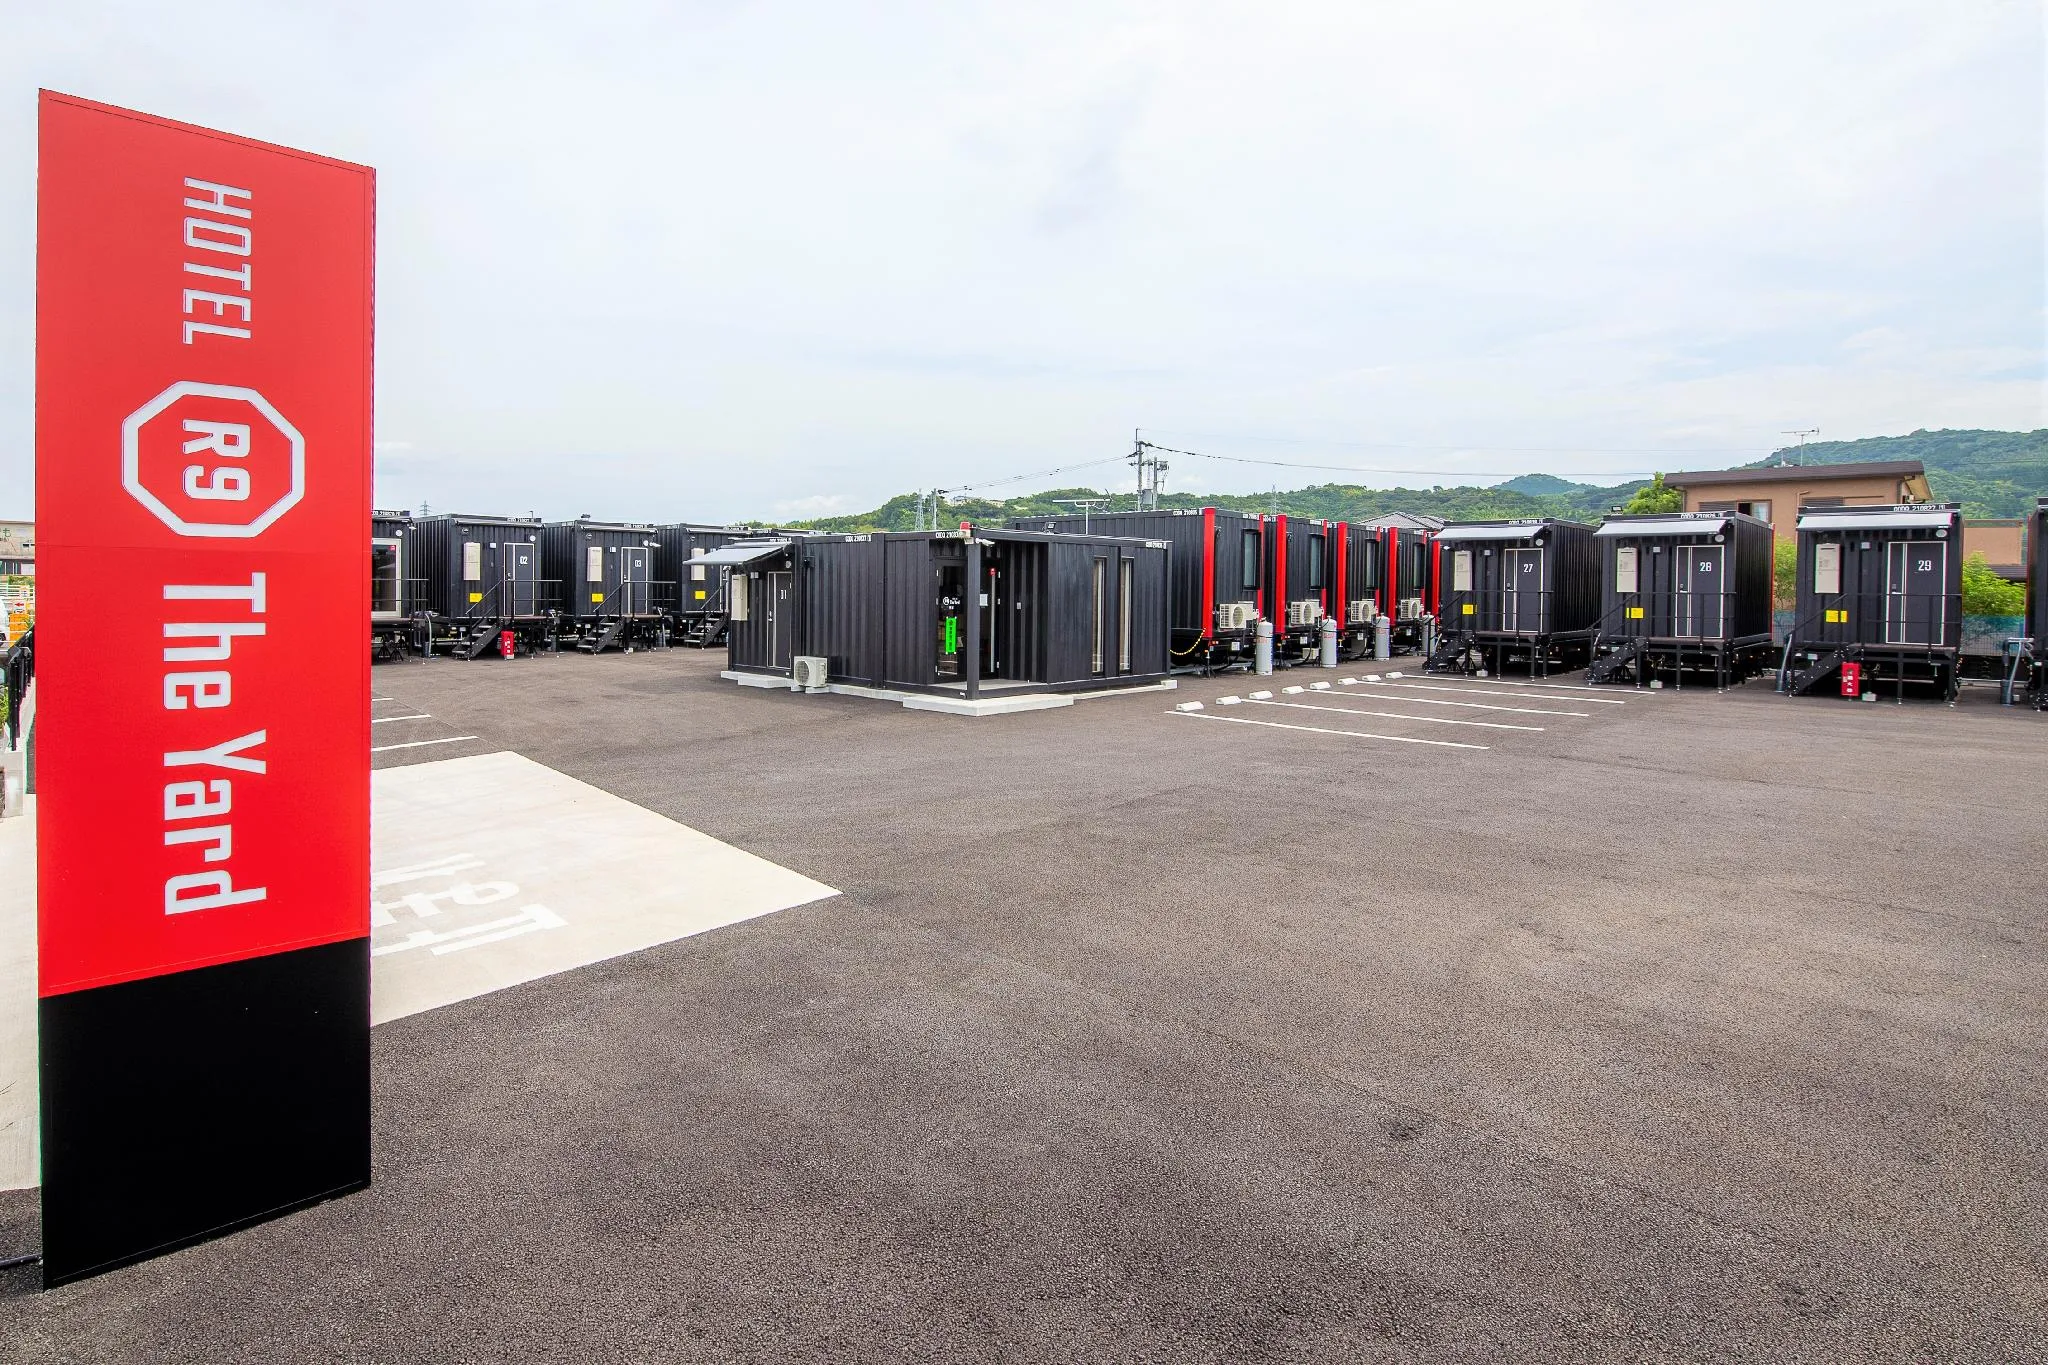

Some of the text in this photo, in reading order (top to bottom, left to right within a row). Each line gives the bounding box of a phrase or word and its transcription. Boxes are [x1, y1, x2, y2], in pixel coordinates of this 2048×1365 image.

[163, 177, 267, 916] HOTEL R9 The Yard
[1523, 563, 1534, 573] 27
[1699, 561, 1712, 572] 28
[1918, 559, 1932, 571] 29
